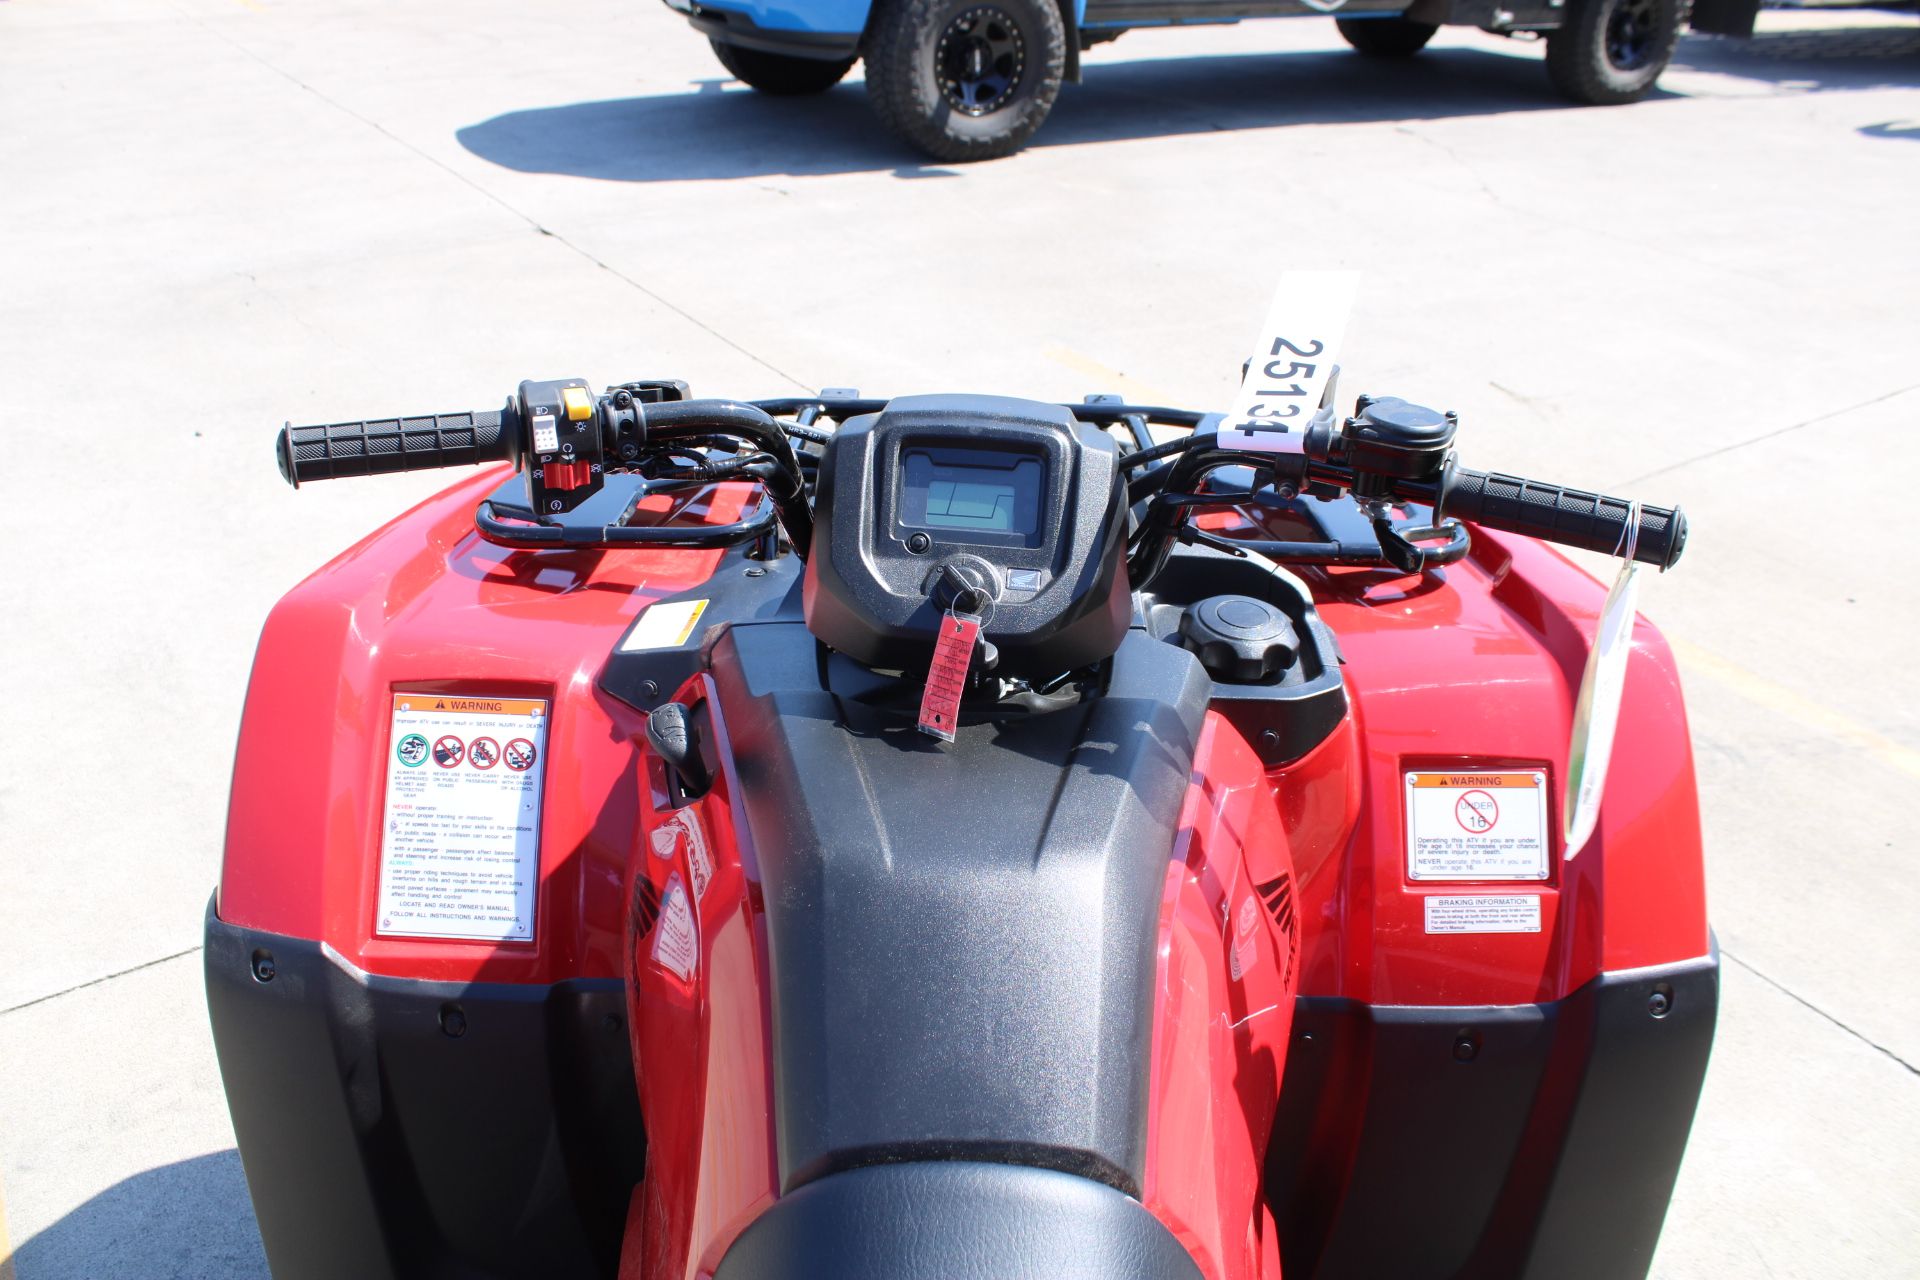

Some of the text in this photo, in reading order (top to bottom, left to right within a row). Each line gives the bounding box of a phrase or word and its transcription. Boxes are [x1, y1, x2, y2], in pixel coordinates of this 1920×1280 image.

[1235, 336, 1324, 436] 25134
[451, 701, 502, 711] WARNING
[1451, 777, 1502, 785] WARNING
[1460, 802, 1493, 810] UNDER
[1470, 816, 1486, 828] 16
